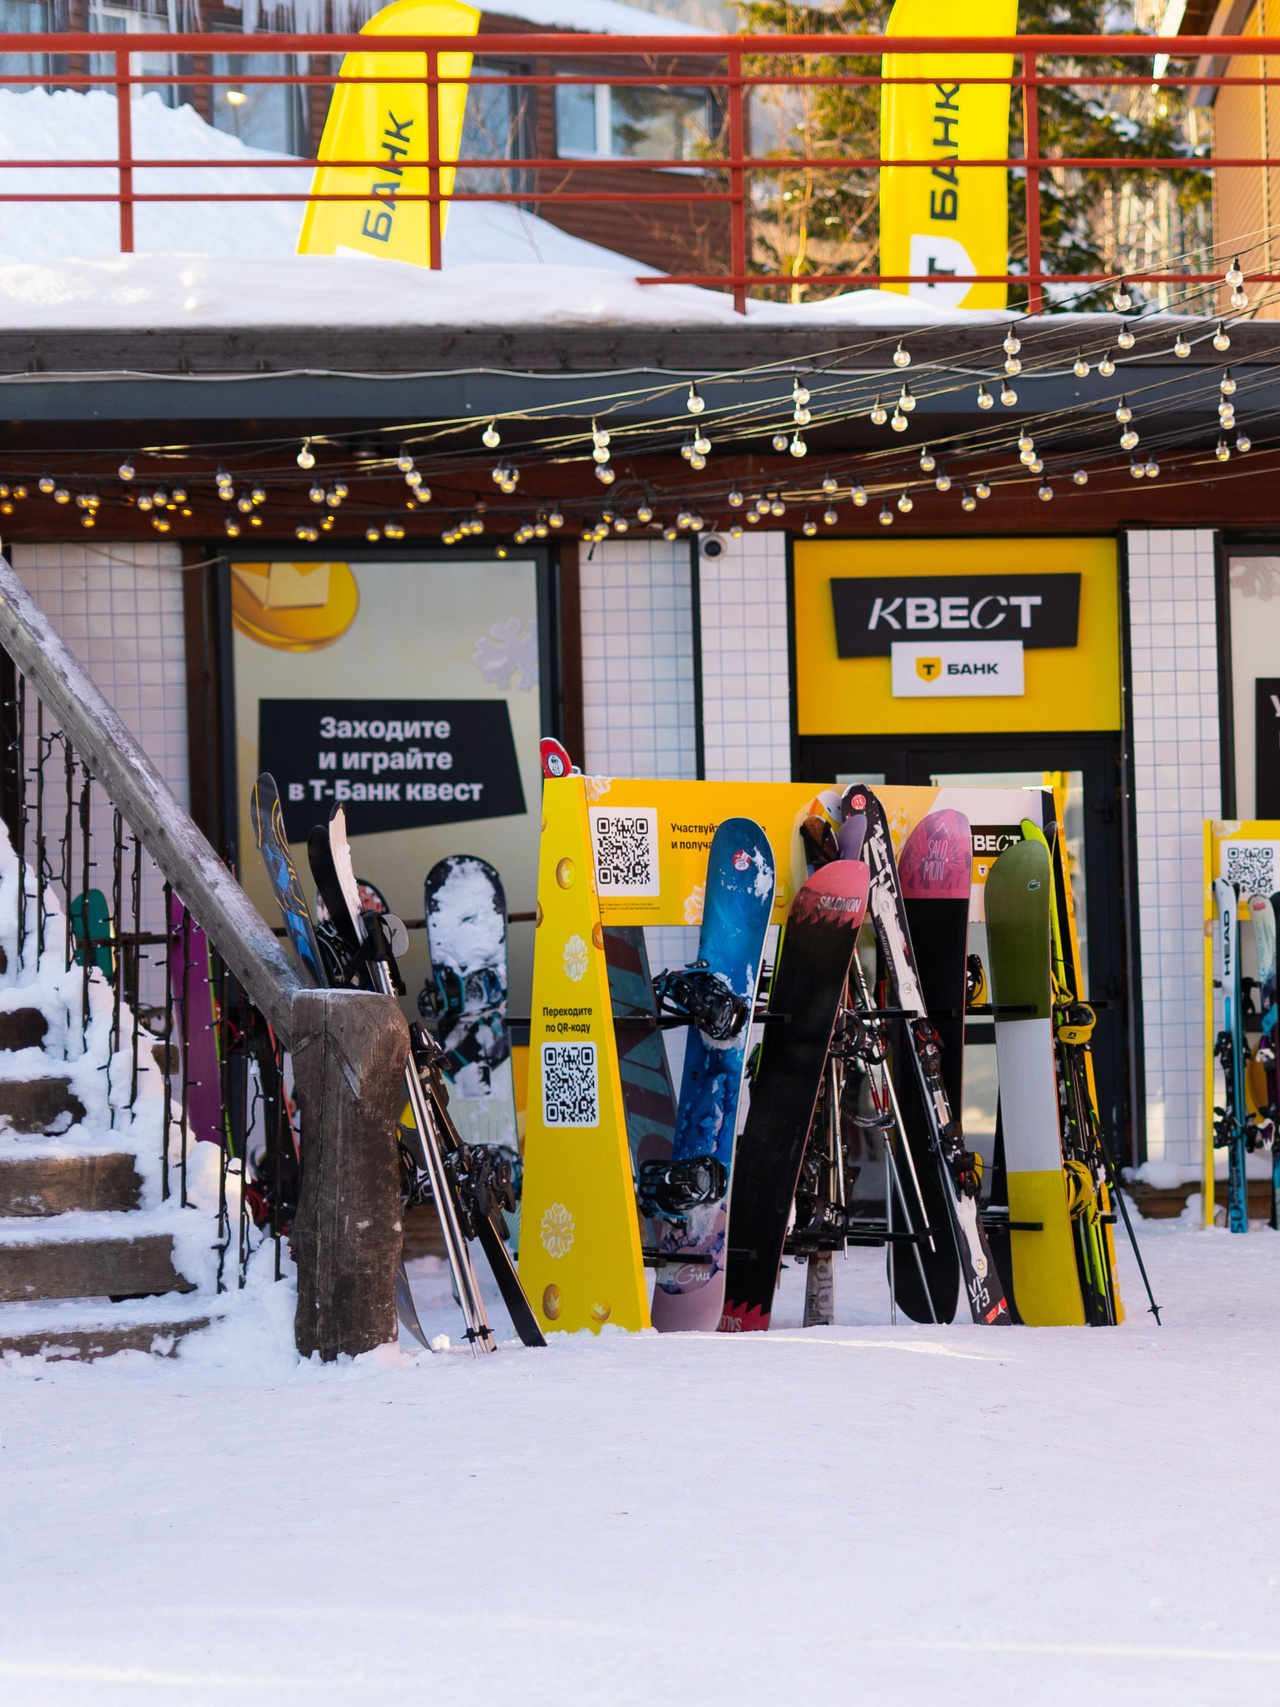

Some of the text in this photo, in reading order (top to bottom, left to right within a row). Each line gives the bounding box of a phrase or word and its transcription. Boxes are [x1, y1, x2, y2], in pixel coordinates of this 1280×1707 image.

[930, 83, 960, 221] БАНК
[361, 109, 414, 242] БАНК
[867, 595, 1043, 630] КВЕСТ
[947, 662, 999, 675] БАНК
[319, 716, 451, 742] Заходите
[318, 747, 453, 775] и играйте
[288, 778, 484, 801] в Т-Банк квест
[671, 841, 678, 849] и
[971, 835, 1021, 852] ВЕСТ
[818, 896, 862, 913] SALOMON
[1223, 910, 1231, 976] HEAD
[542, 1007, 593, 1019] Переходите
[545, 1022, 591, 1034] по QR-коду
